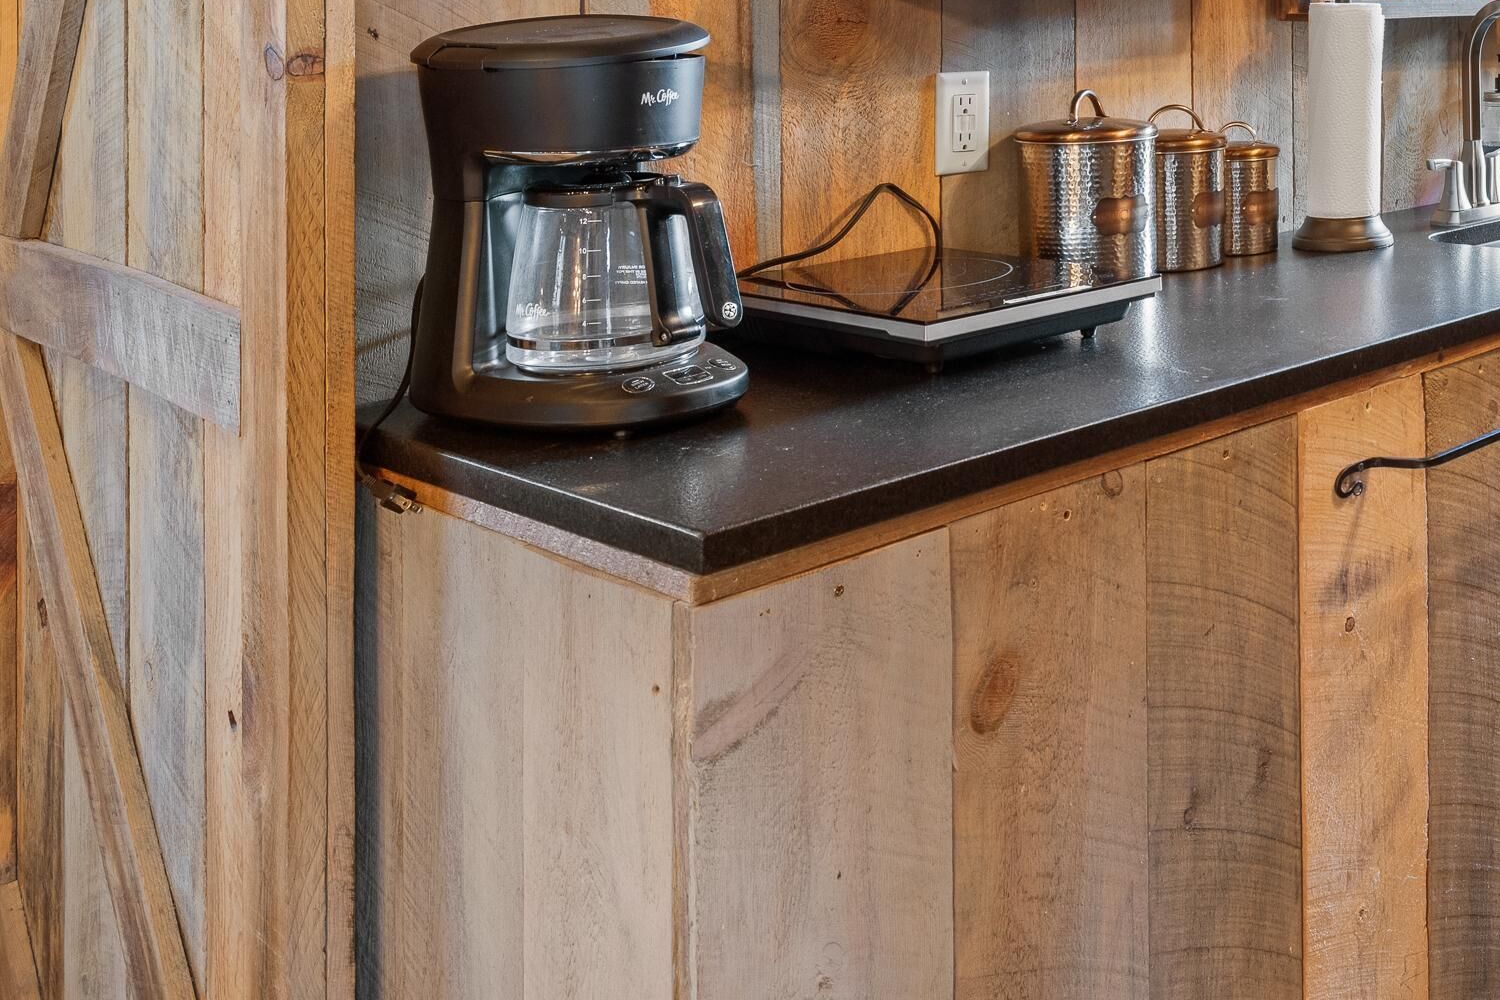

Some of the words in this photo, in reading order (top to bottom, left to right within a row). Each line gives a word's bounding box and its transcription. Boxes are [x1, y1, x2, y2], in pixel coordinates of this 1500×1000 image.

[641, 92, 656, 106] Mr.
[656, 88, 680, 106] Coffee
[525, 302, 550, 318] Coffee
